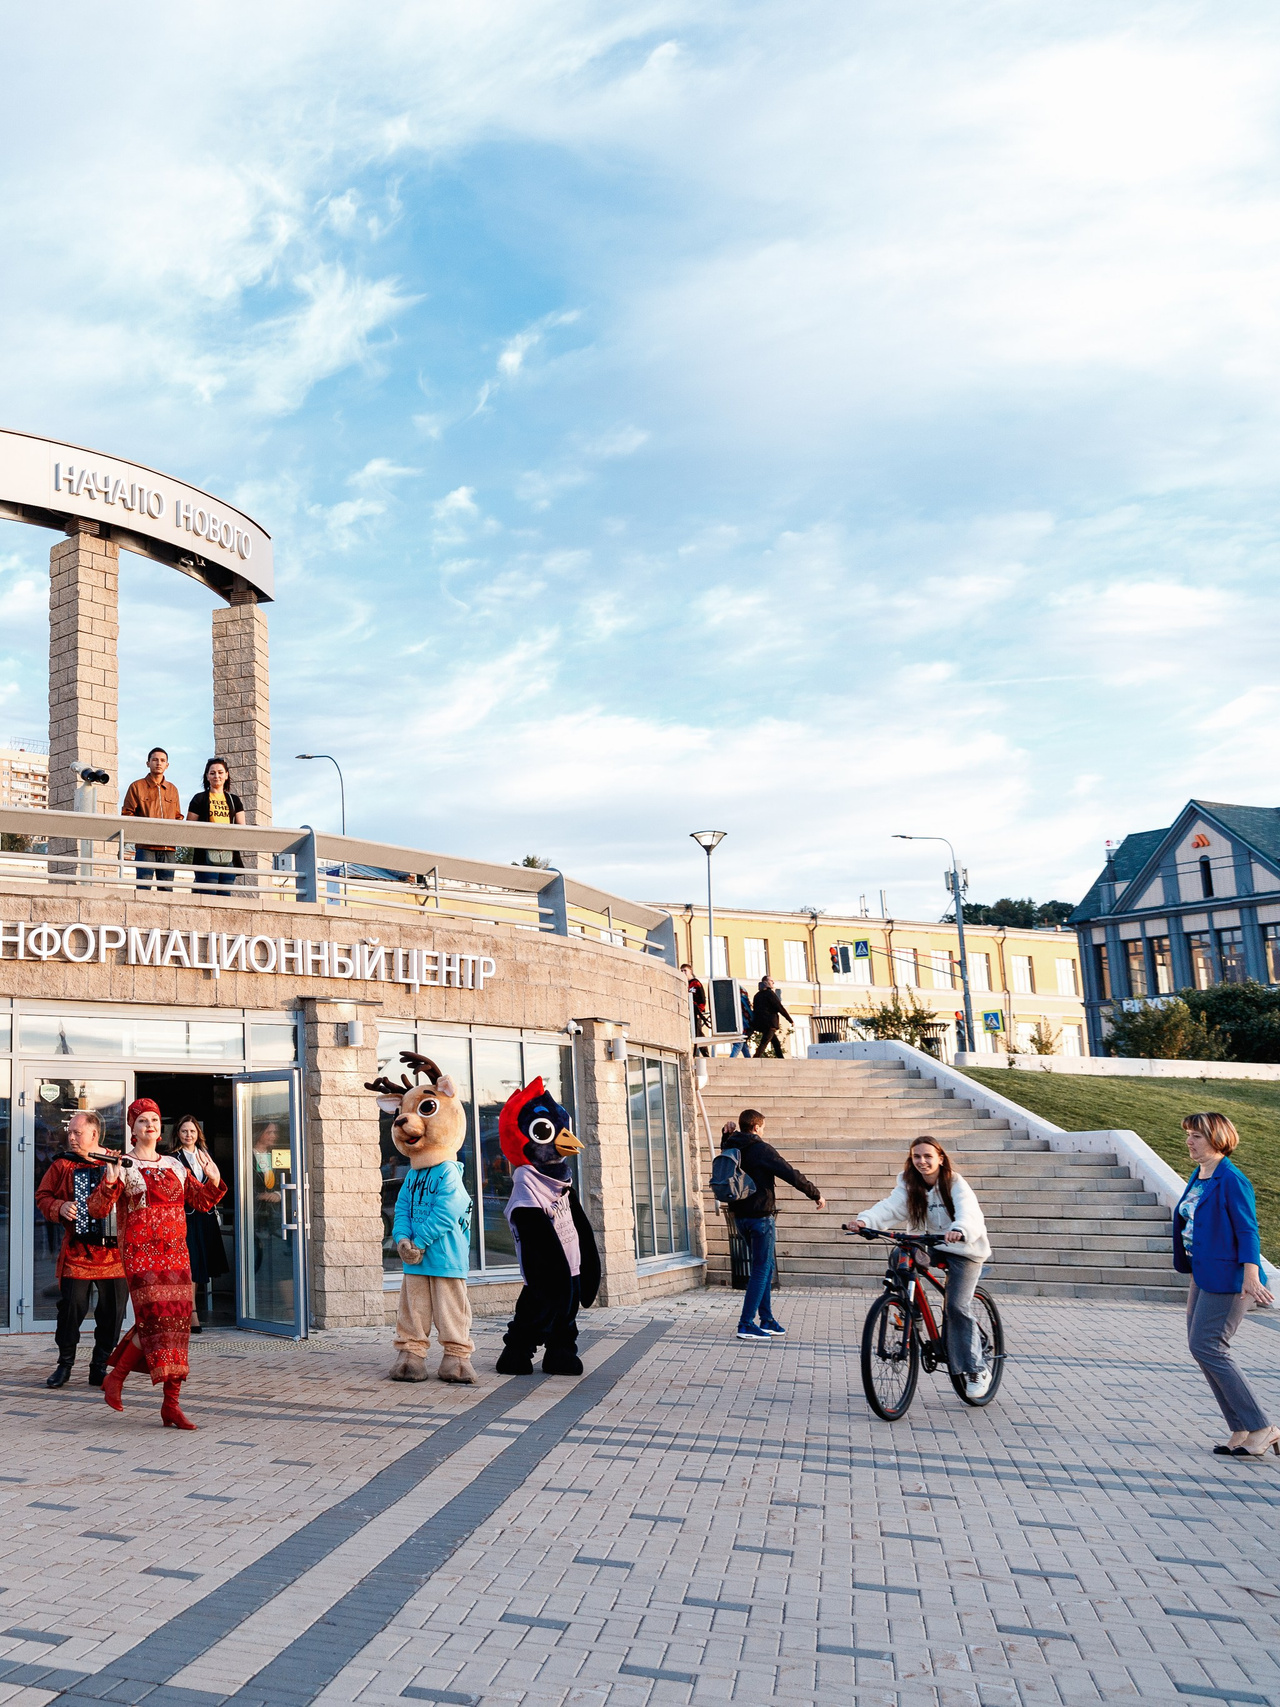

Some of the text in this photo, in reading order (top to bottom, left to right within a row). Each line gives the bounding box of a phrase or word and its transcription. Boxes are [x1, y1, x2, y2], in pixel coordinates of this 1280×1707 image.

[55, 462, 252, 560] НАЧАЛО НОВОГО
[393, 946, 497, 994] ЦЕНТР
